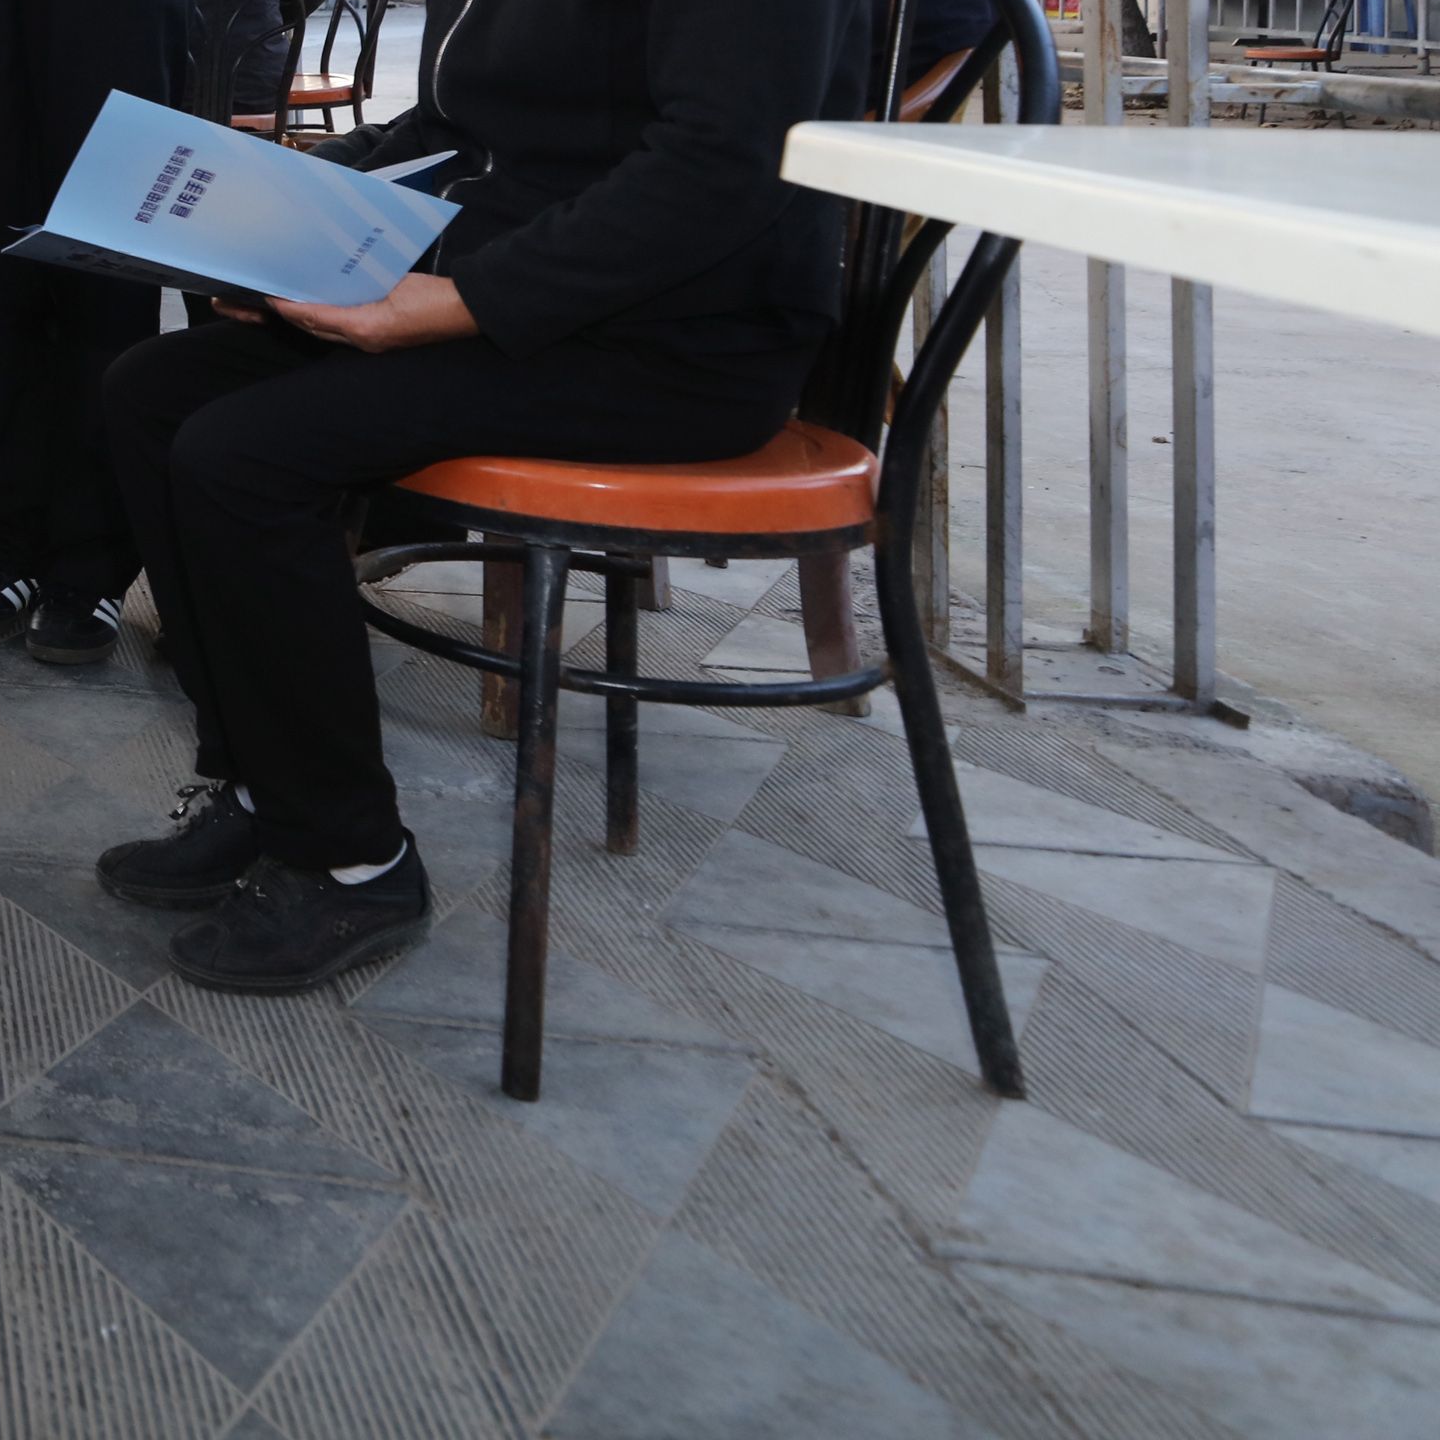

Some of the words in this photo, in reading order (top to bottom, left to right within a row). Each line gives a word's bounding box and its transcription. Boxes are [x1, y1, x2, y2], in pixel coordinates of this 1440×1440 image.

[134, 145, 194, 224] 防范电信网络诈骗
[169, 167, 216, 219] 宣传手册
